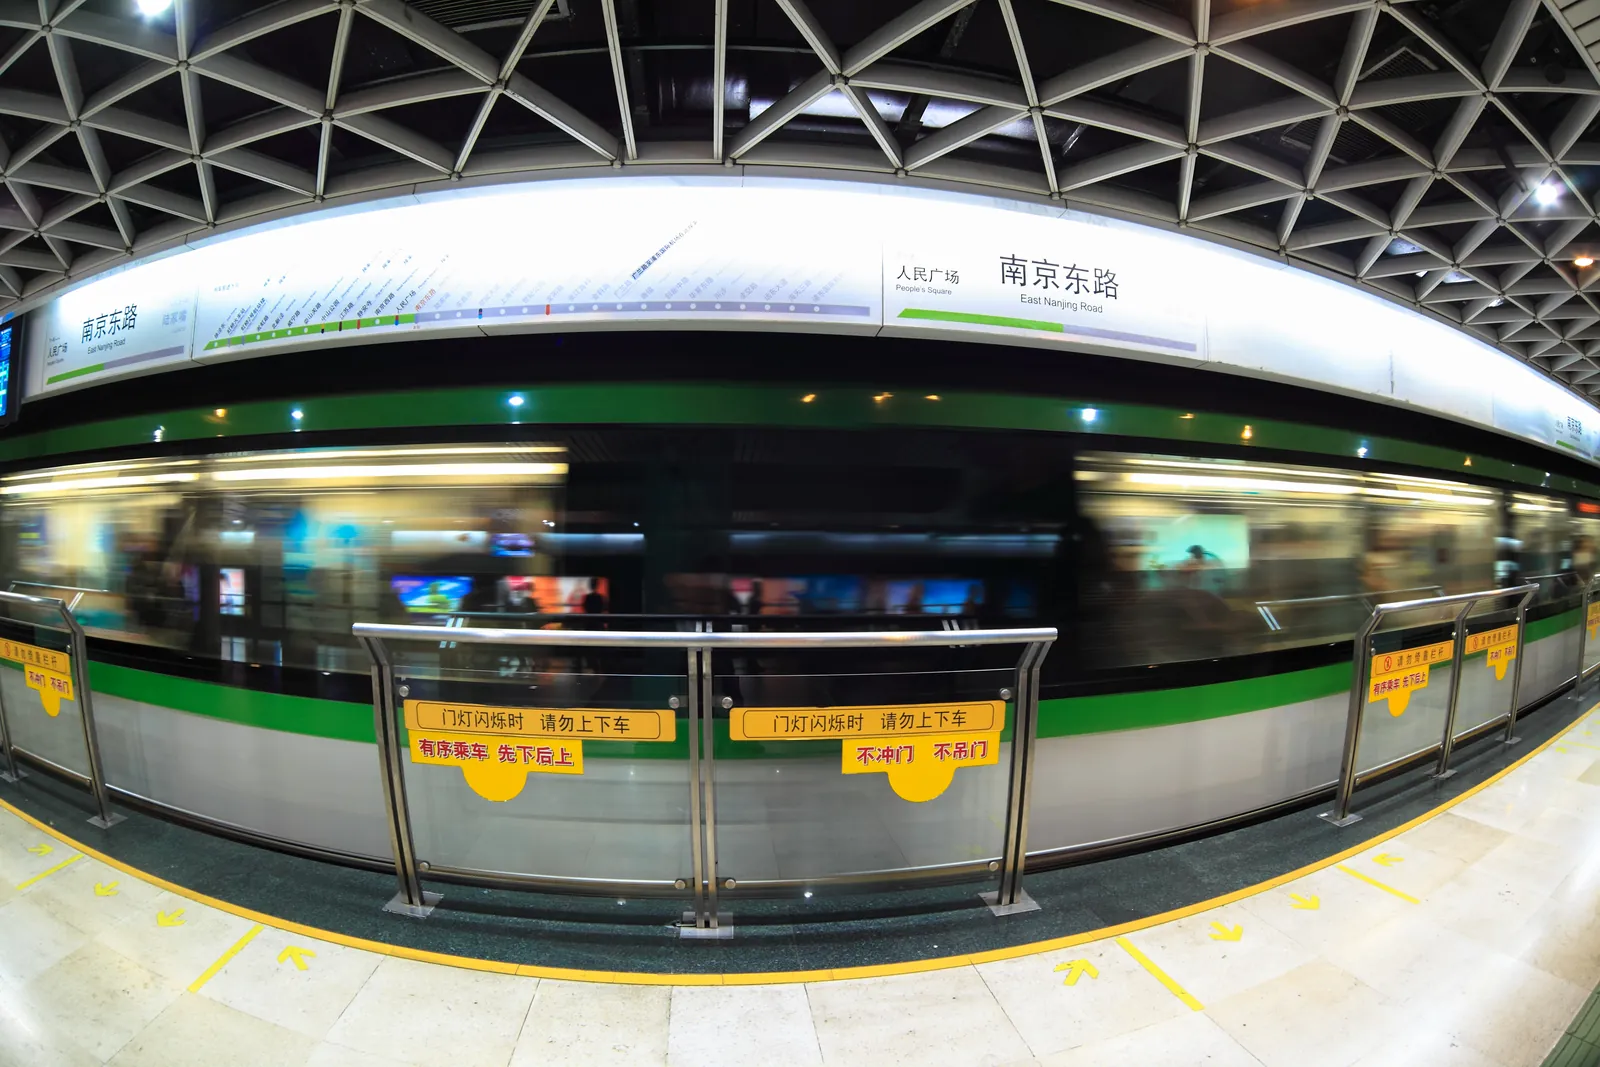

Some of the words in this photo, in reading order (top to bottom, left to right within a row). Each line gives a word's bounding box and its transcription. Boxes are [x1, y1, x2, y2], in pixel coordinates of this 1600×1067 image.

[896, 264, 960, 285] 人民广场
[999, 253, 1120, 300] 南京东路
[396, 289, 417, 313] 人民广场
[895, 284, 926, 294] People's
[927, 285, 953, 297] Square
[1020, 293, 1042, 306] East
[1043, 296, 1079, 312] Nanjing
[1080, 301, 1103, 314] Road
[81, 303, 138, 344] 南京东路
[87, 346, 97, 355] East
[97, 342, 113, 352] Nanjing
[113, 338, 126, 347] Road
[1373, 678, 1400, 696] 有序乘车
[1402, 672, 1426, 688] 先下后上
[442, 708, 524, 731] 门灯闪烁时
[540, 713, 631, 735] 请勿上下车
[773, 713, 864, 734] 门灯闪烁时
[881, 709, 968, 731] 请勿上下车
[418, 738, 489, 761] 有序乘车
[497, 743, 574, 767] 先下后上
[856, 745, 915, 766] 不冲门
[933, 740, 988, 761] 不吊门
